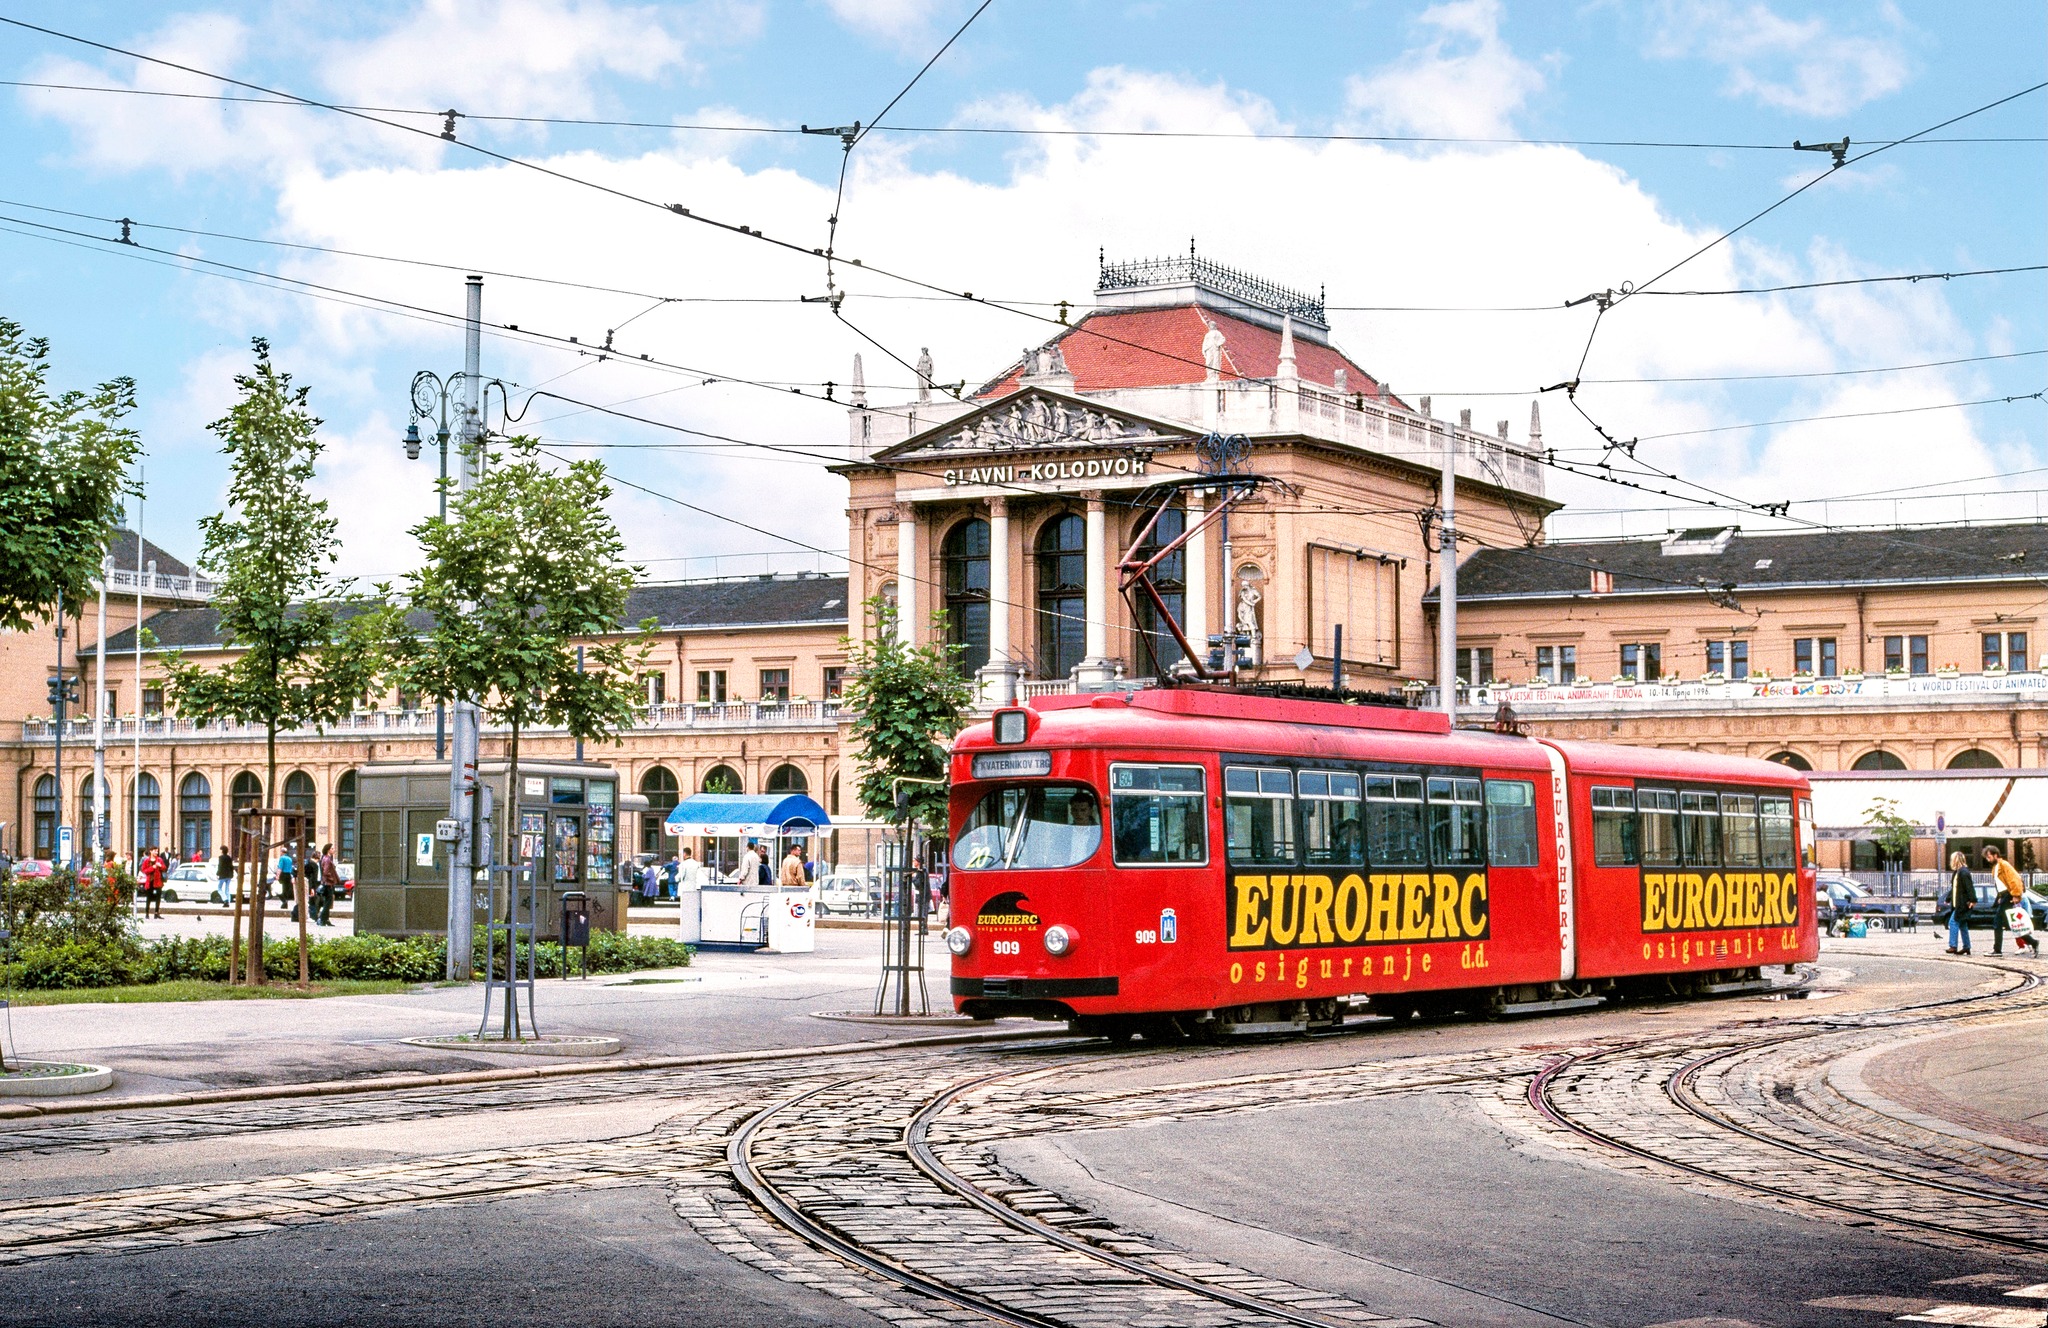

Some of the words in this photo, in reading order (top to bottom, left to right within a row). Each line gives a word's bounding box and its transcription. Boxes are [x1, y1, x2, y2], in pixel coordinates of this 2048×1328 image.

[943, 465, 1013, 486] GLAVNI
[1031, 458, 1145, 481] KOLODVOR
[1505, 691, 1534, 702] SVJETSKI
[1536, 690, 1565, 701] FESTIVAL
[1567, 689, 1610, 700] ANIMIRANIH
[1612, 688, 1643, 699] FILMOVA
[1908, 682, 1917, 692] 12
[1922, 681, 1952, 692] WORLD
[1955, 680, 1990, 691] FESTIVAL
[1992, 679, 2002, 690] OF
[2005, 678, 2047, 689] ANIMATED
[980, 759, 1033, 771] KVATERNIKOV
[1035, 759, 1050, 769] TRG
[965, 846, 991, 869] 20
[1554, 777, 1568, 950] EUROHERC
[1230, 873, 1487, 947] EUROHERC
[1643, 873, 1797, 931] EUROHERC
[977, 914, 1038, 925] EUROHERC
[993, 940, 1020, 955] 909
[1135, 930, 1157, 944] 909
[1643, 932, 1765, 964] osiguranje
[1782, 929, 1798, 951] d.d.
[1230, 947, 1432, 989] osiguranje
[1461, 944, 1489, 970] d.d.
